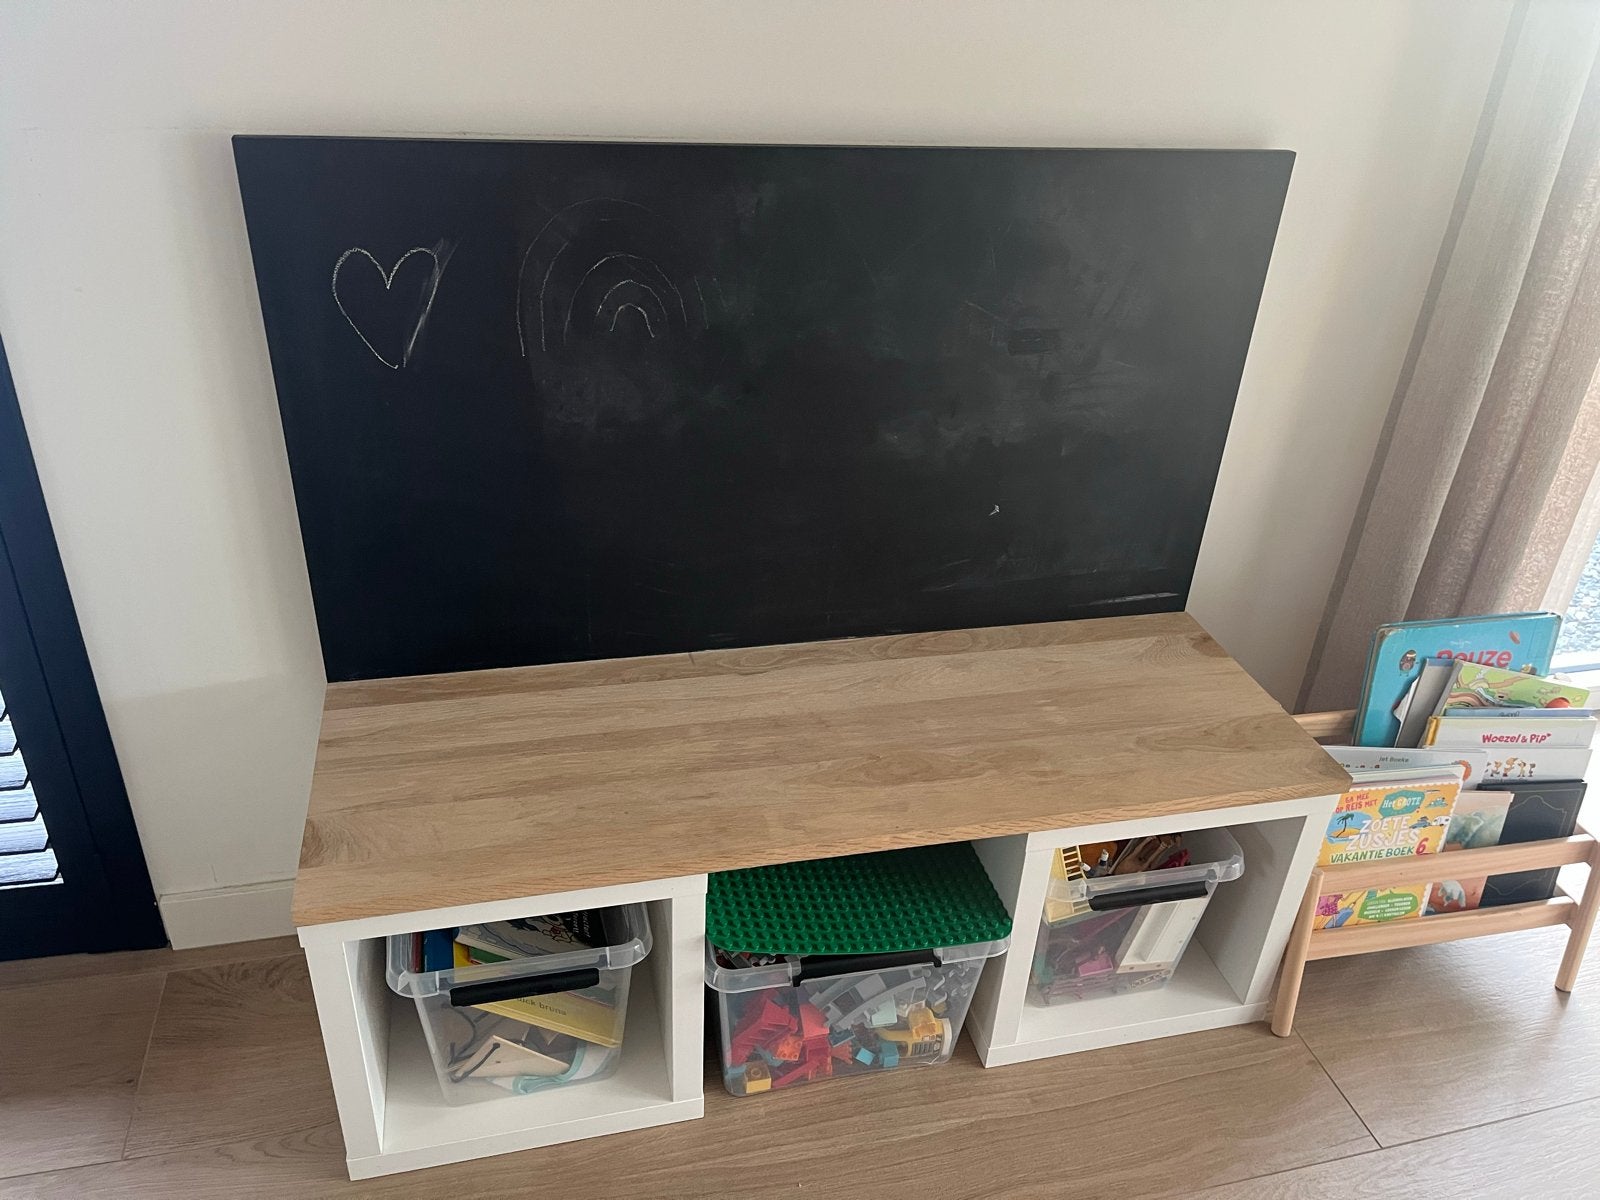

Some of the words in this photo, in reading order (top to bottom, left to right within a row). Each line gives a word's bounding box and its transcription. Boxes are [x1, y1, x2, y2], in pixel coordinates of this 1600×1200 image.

[1482, 731, 1521, 743] Woezel
[1521, 735, 1528, 743] &
[1530, 733, 1547, 744] Pip
[1356, 792, 1370, 801] MEE
[1335, 806, 1343, 814] OP
[1345, 801, 1363, 812] REIS
[1364, 799, 1378, 808] MET
[1360, 816, 1411, 834] ZOETE
[1346, 828, 1420, 851] ZUSJES
[1415, 837, 1430, 856] 6
